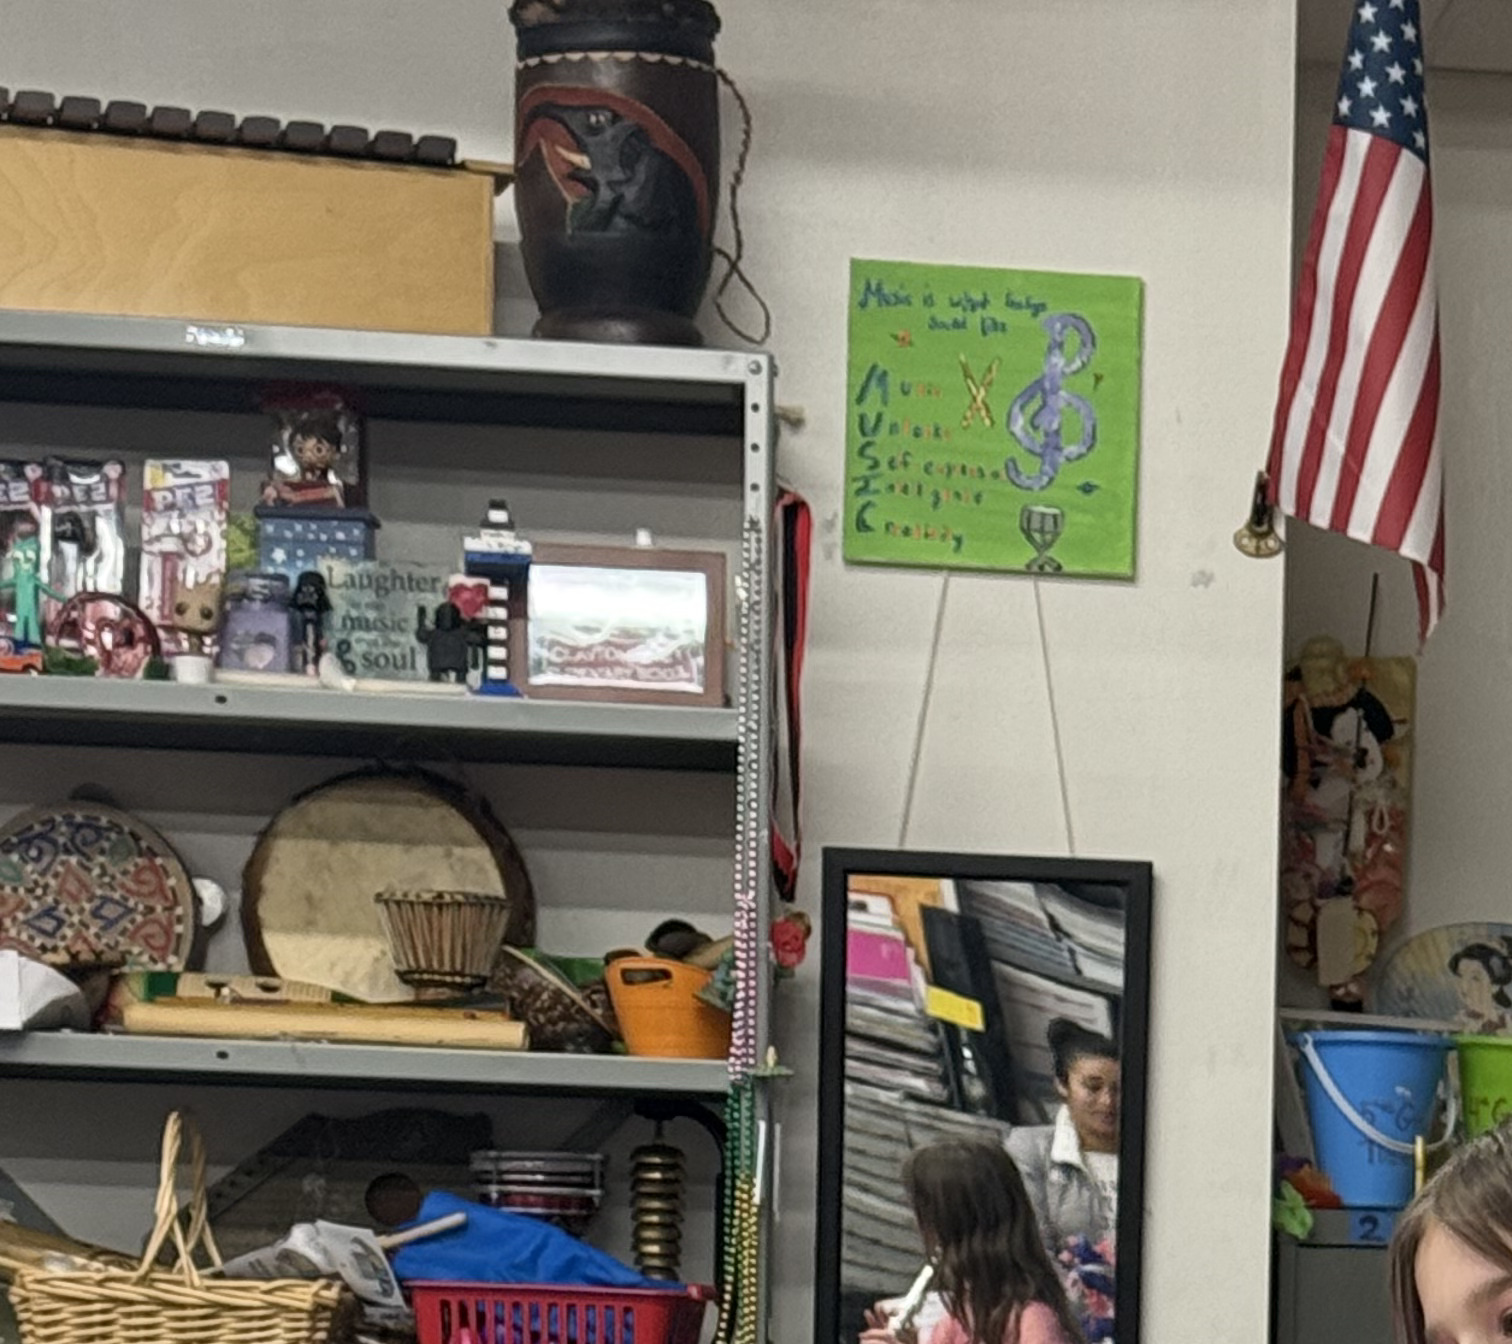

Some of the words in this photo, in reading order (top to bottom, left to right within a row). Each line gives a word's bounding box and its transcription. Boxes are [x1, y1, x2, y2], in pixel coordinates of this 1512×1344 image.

[326, 565, 441, 598] Laughter
[341, 611, 409, 632] music
[361, 646, 417, 671] soul
[1358, 1216, 1384, 1240] 2
